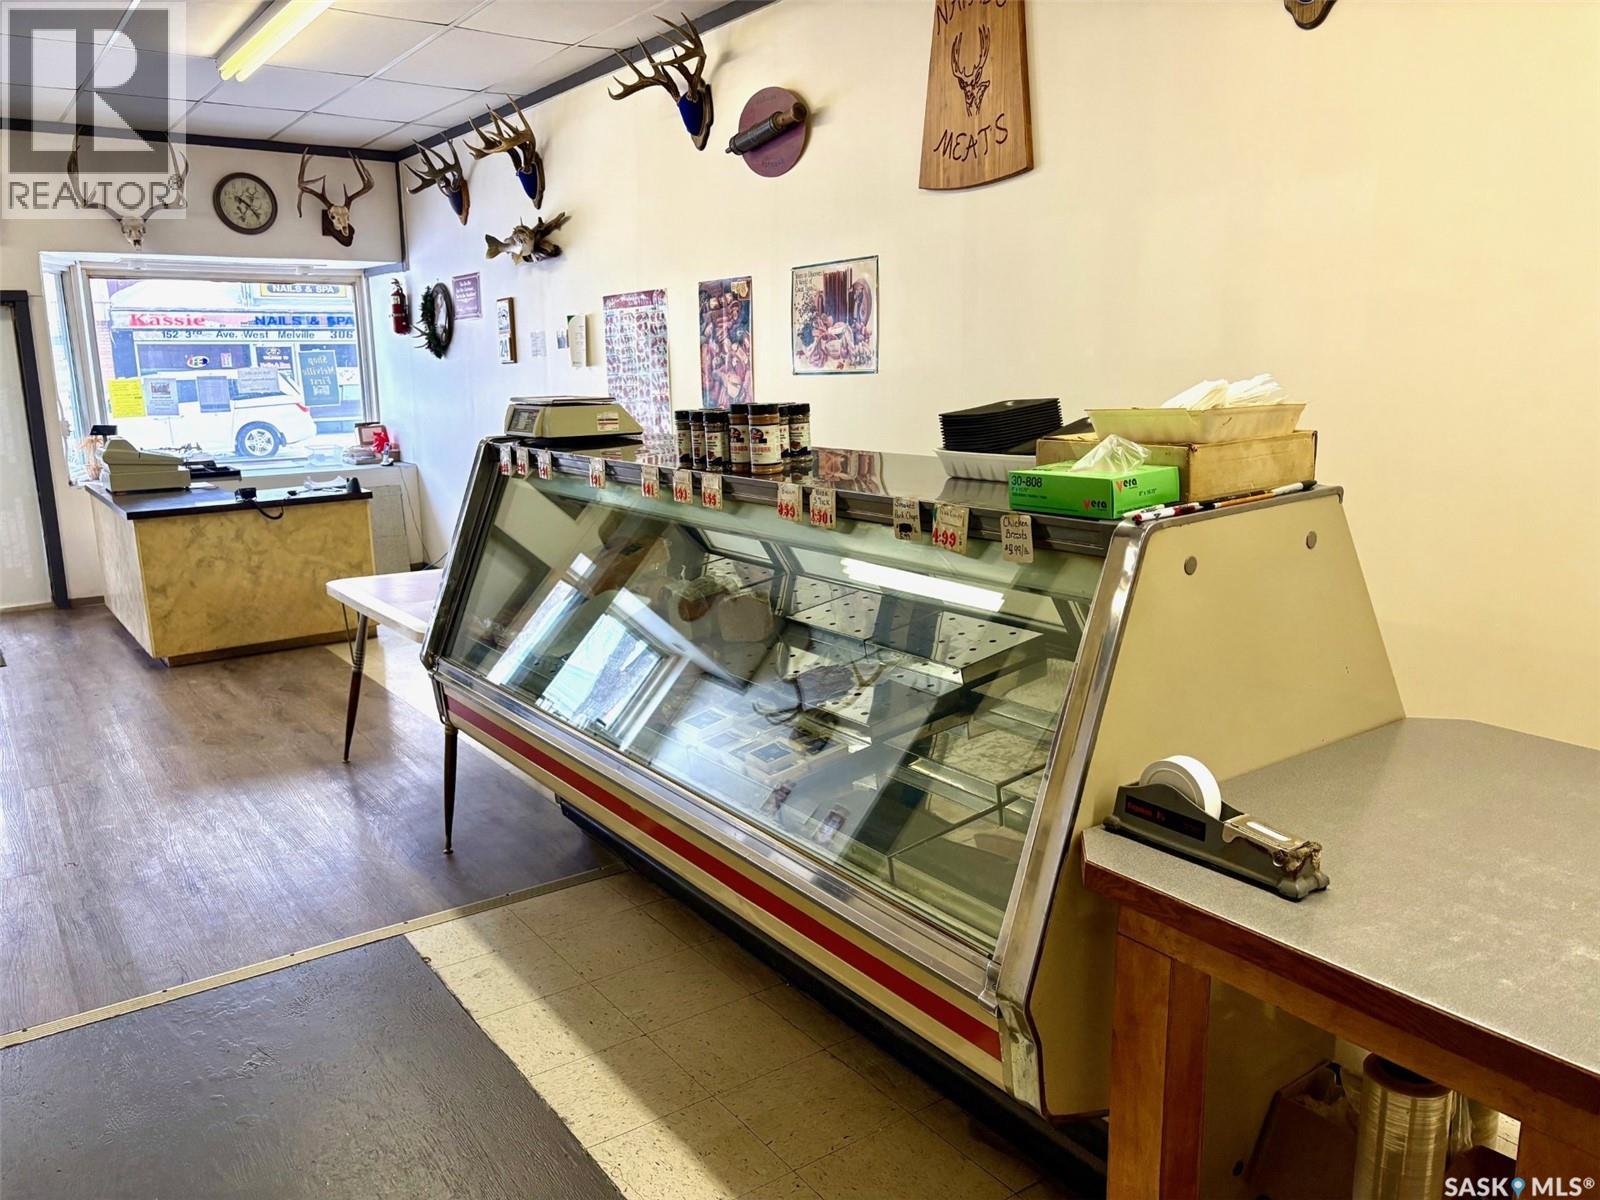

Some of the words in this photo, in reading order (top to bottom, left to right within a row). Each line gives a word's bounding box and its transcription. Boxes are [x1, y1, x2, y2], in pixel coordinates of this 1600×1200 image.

[933, 113, 1009, 162] MEATS
[272, 284, 301, 293] NAILS
[315, 285, 334, 293] SPA
[129, 313, 206, 327] Kassie
[255, 316, 301, 326] NAILS
[310, 316, 320, 326] &
[327, 316, 354, 327] SPA
[162, 330, 179, 339] 152
[243, 330, 269, 339] West
[278, 330, 315, 339] Melville
[330, 330, 353, 339] 306
[1011, 475, 1043, 488] 30-808
[1003, 516, 1029, 527] Chicken
